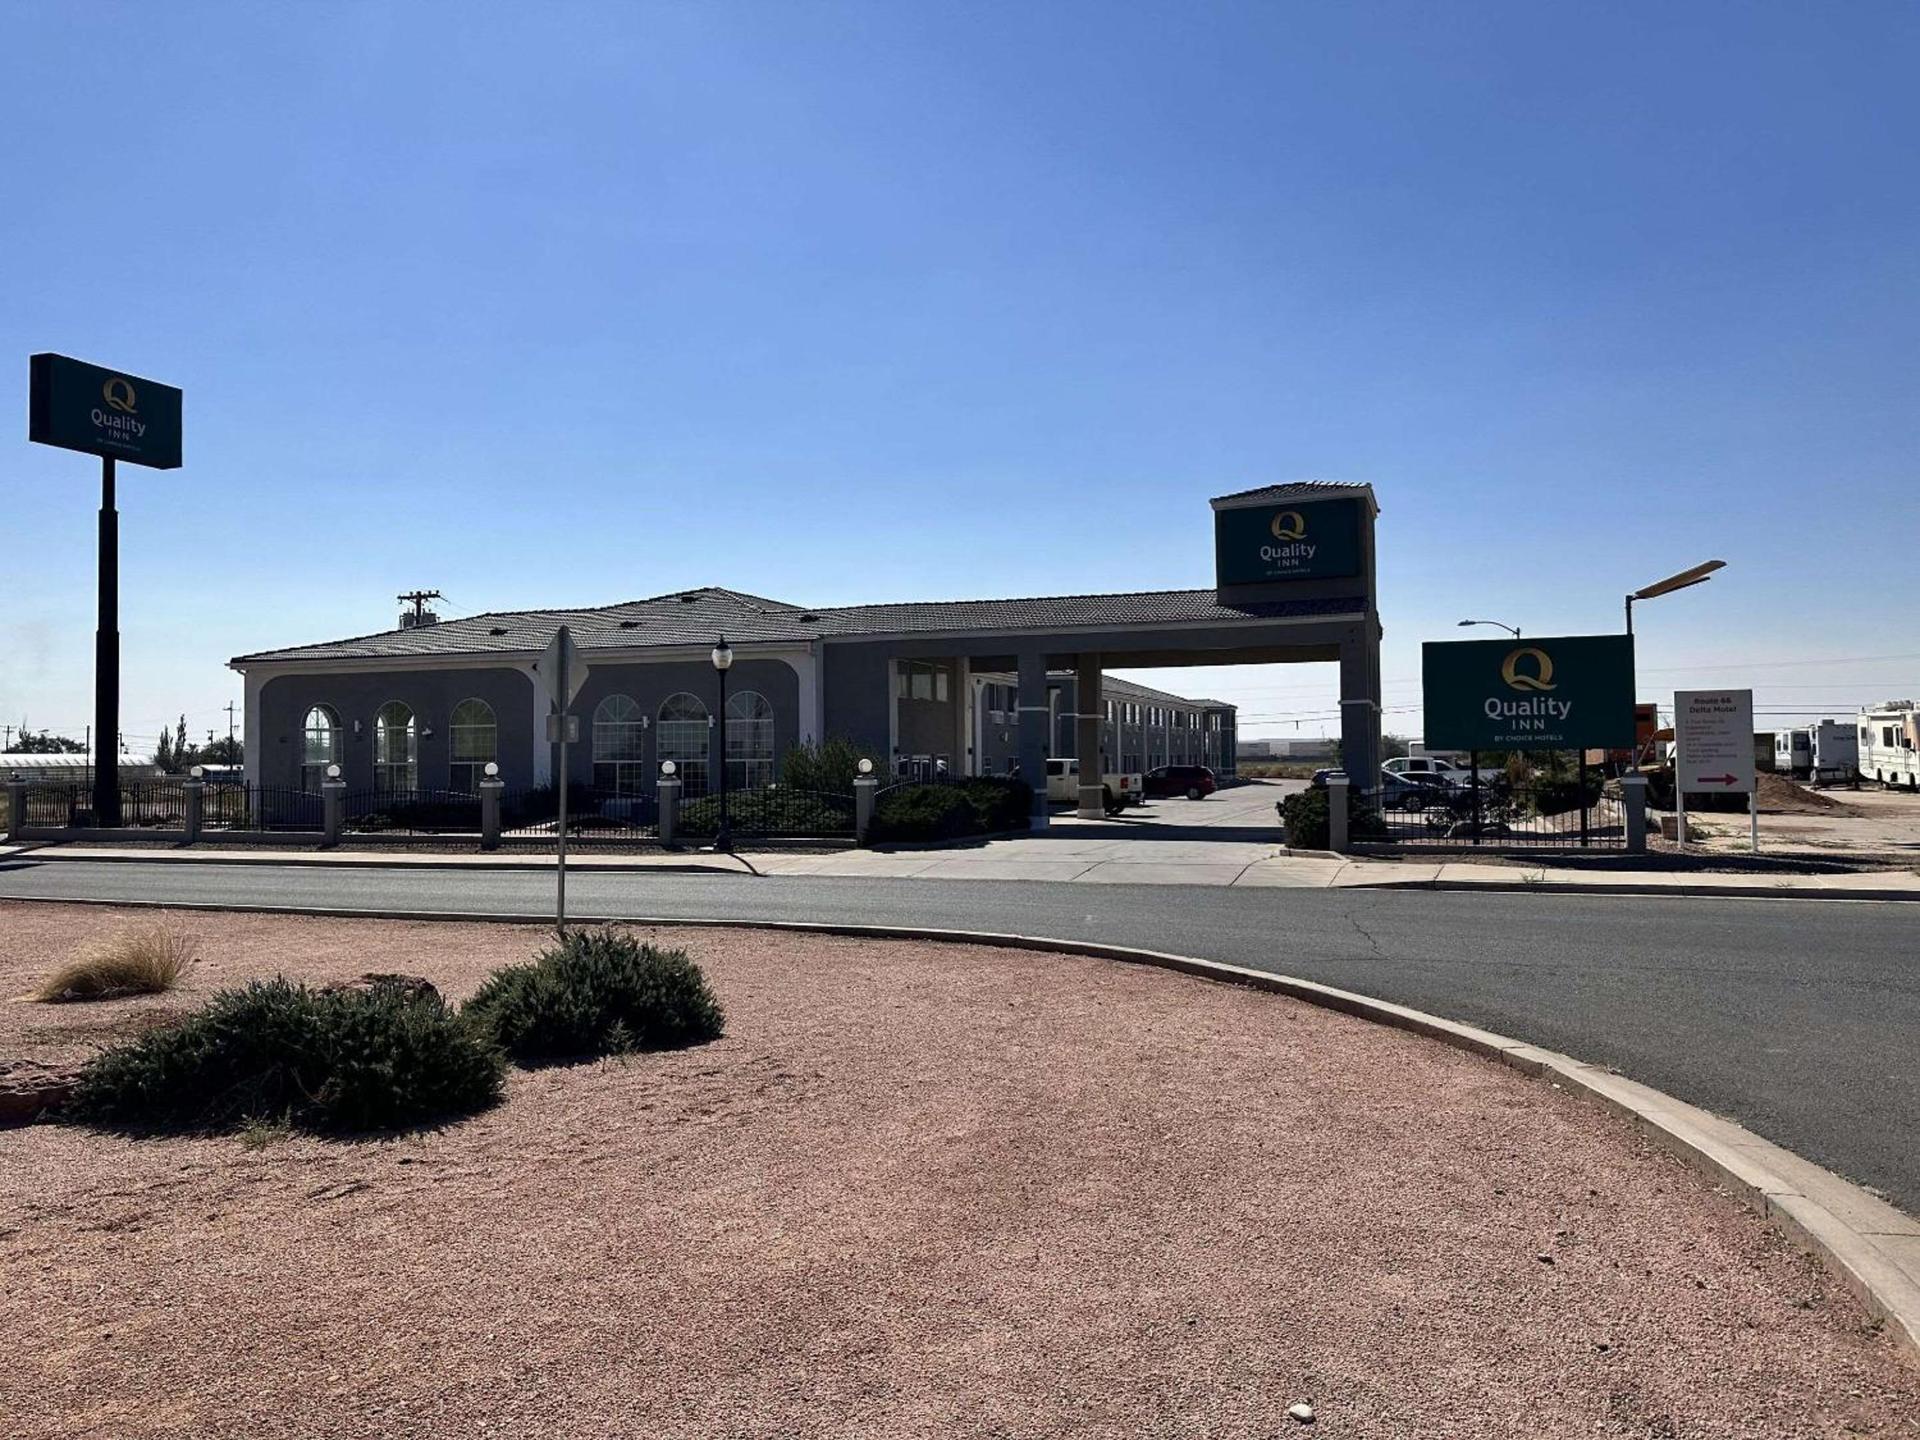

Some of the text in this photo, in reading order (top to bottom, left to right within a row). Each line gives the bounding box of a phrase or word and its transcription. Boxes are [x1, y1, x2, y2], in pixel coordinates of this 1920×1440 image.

[103, 377, 138, 414] Q
[91, 408, 146, 437] Quality
[108, 428, 130, 441] INN
[1271, 511, 1308, 541] Q
[1260, 543, 1316, 561] Quality
[1277, 558, 1299, 568] INN
[1501, 647, 1558, 691] Q
[1484, 696, 1572, 720] Quality
[1689, 705, 1737, 713] Delta Motel
[1512, 718, 1545, 731] INN
